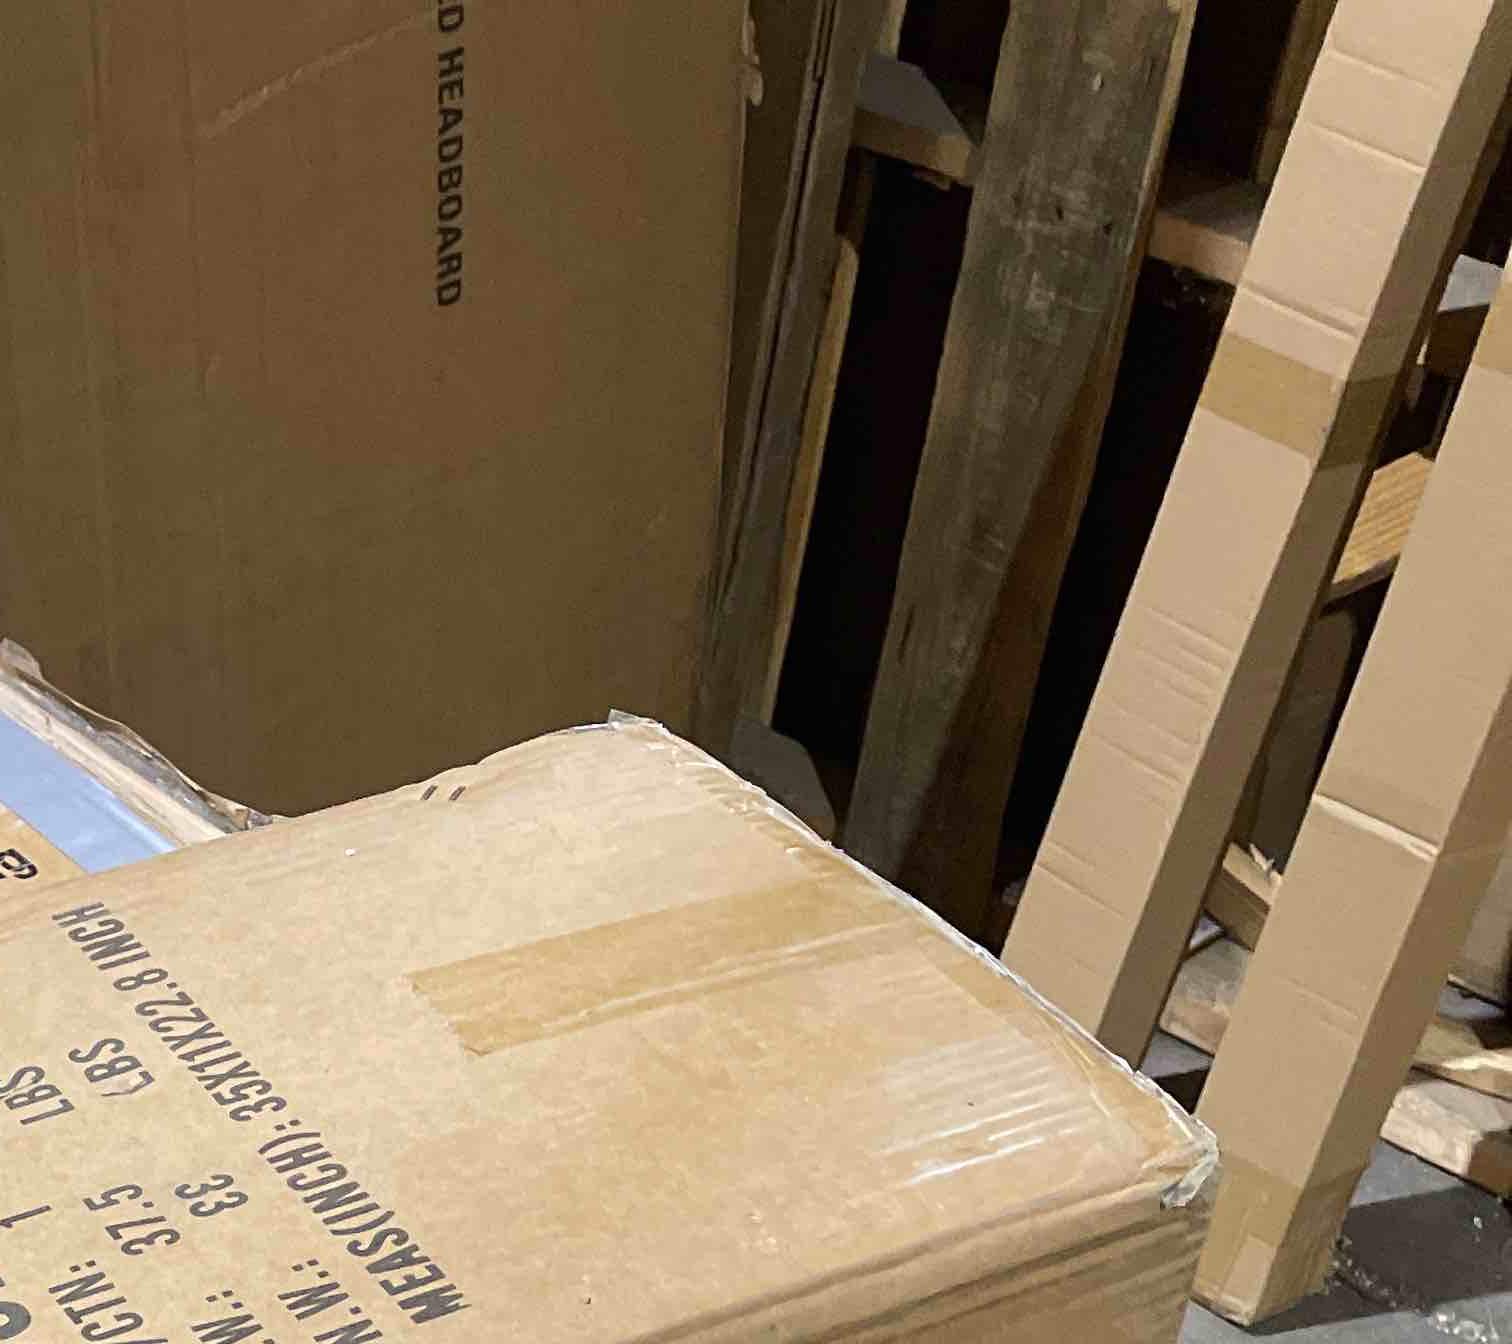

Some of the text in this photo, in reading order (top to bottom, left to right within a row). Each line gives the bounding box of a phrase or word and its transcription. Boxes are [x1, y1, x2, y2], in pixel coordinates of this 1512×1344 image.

[437, 47, 465, 307] HEADBOARD
[51, 901, 152, 971] INCH
[67, 1037, 156, 1098] LBS
[111, 967, 289, 1122] 35X11X22.8
[81, 1183, 182, 1257] 37.5
[174, 1173, 250, 1218] 33
